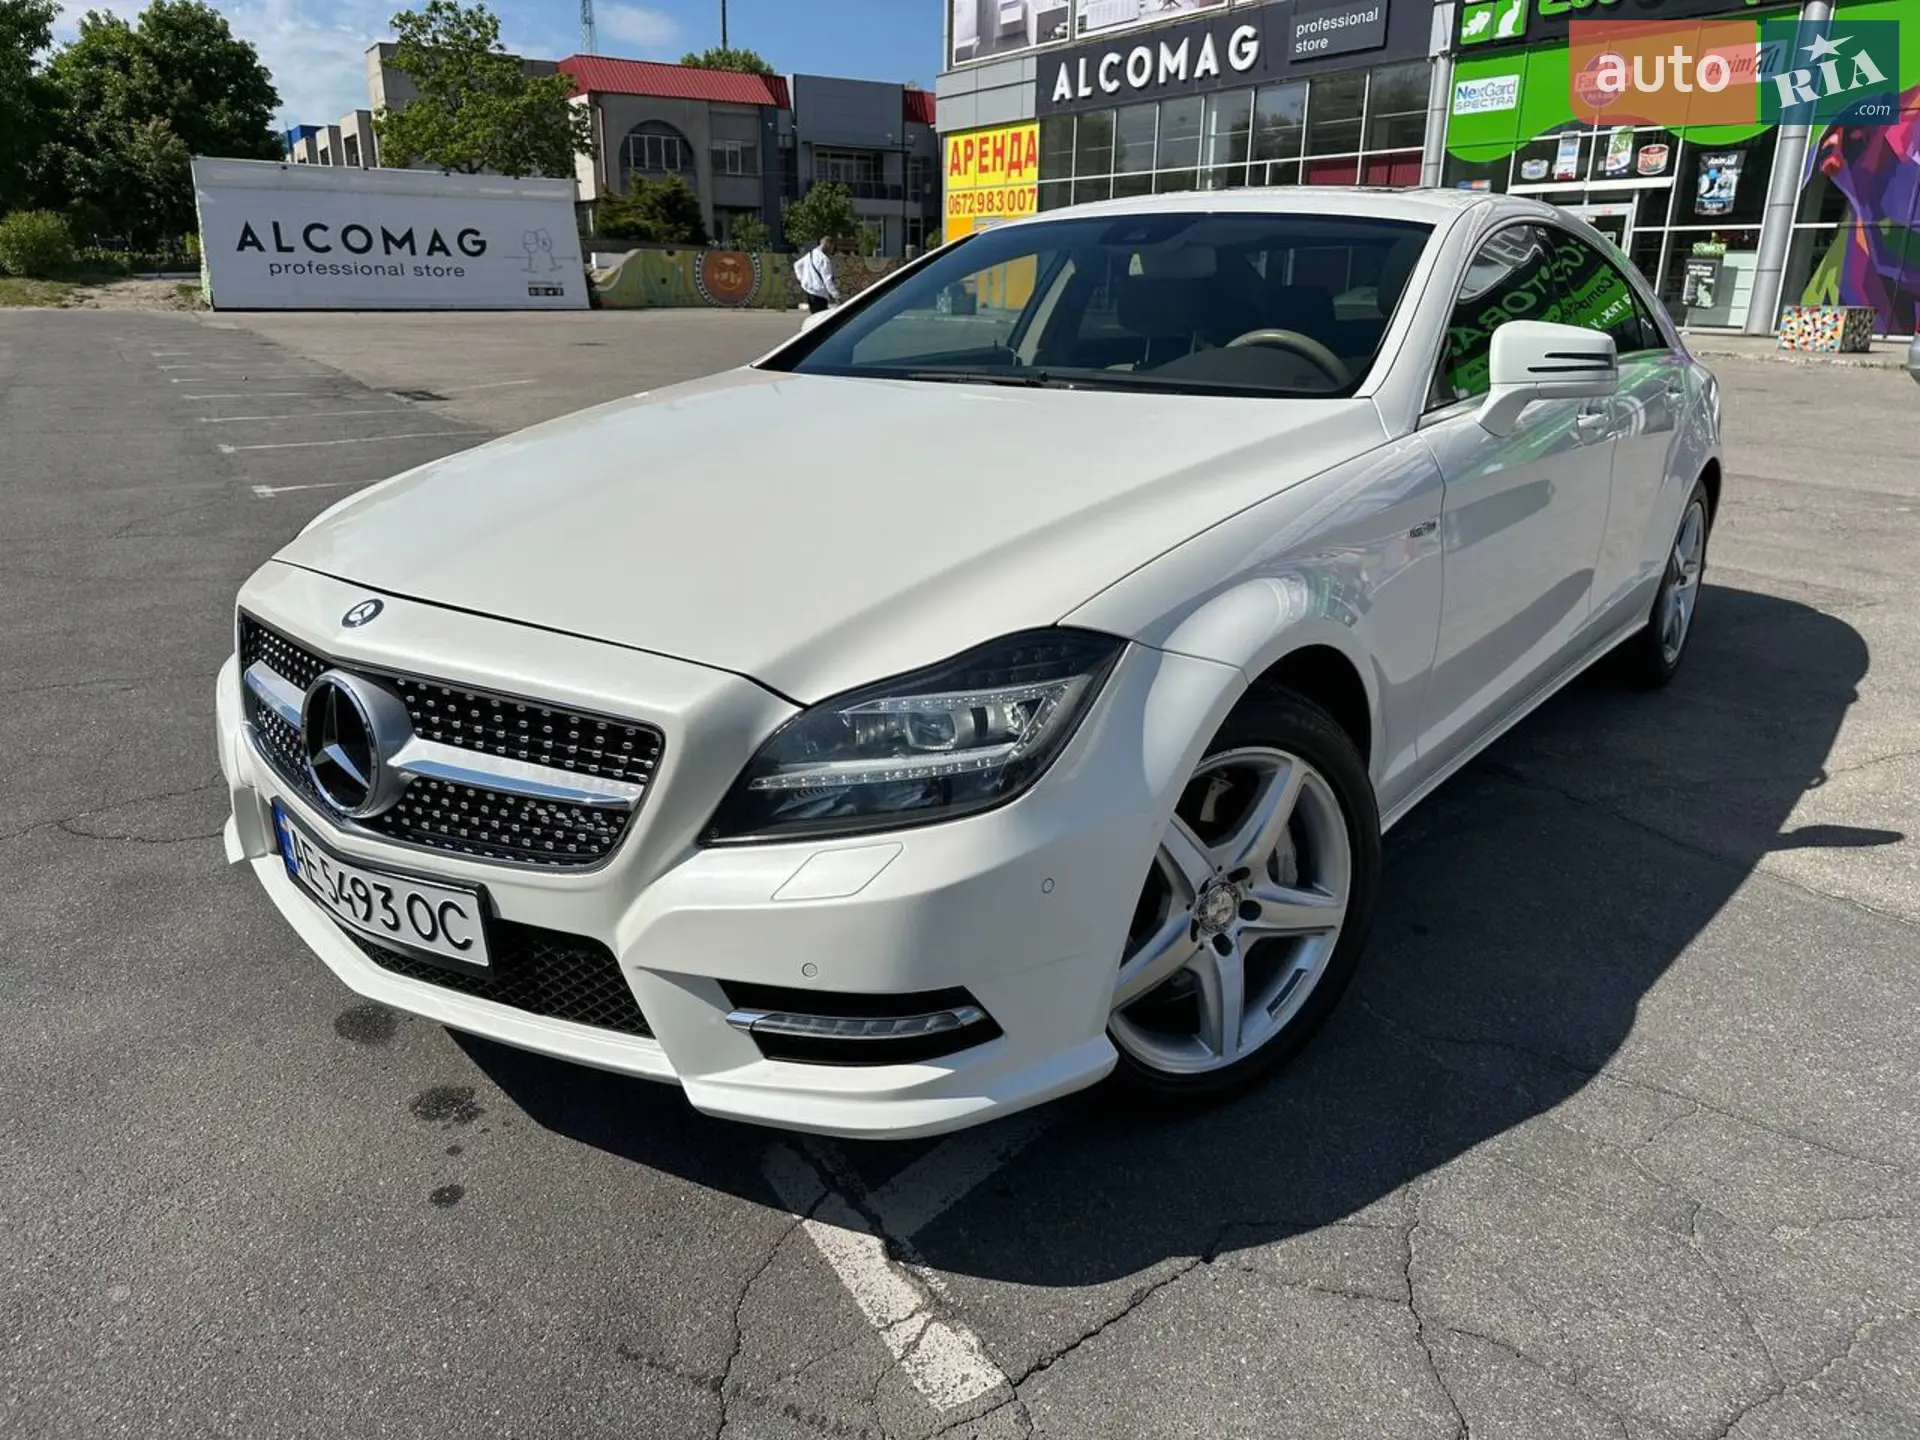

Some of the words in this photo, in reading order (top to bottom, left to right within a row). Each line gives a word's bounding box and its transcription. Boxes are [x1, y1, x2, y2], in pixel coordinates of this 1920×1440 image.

[1296, 7, 1379, 38] professional
[1295, 38, 1329, 54] store
[1052, 24, 1260, 103] ALCOMAG
[1455, 96, 1515, 110] SPECTRA
[1456, 81, 1517, 100] NexGard
[949, 129, 1038, 178] АРЕНДА
[236, 221, 487, 258] ALCOMAG
[269, 260, 405, 277] professional
[413, 263, 466, 278] store
